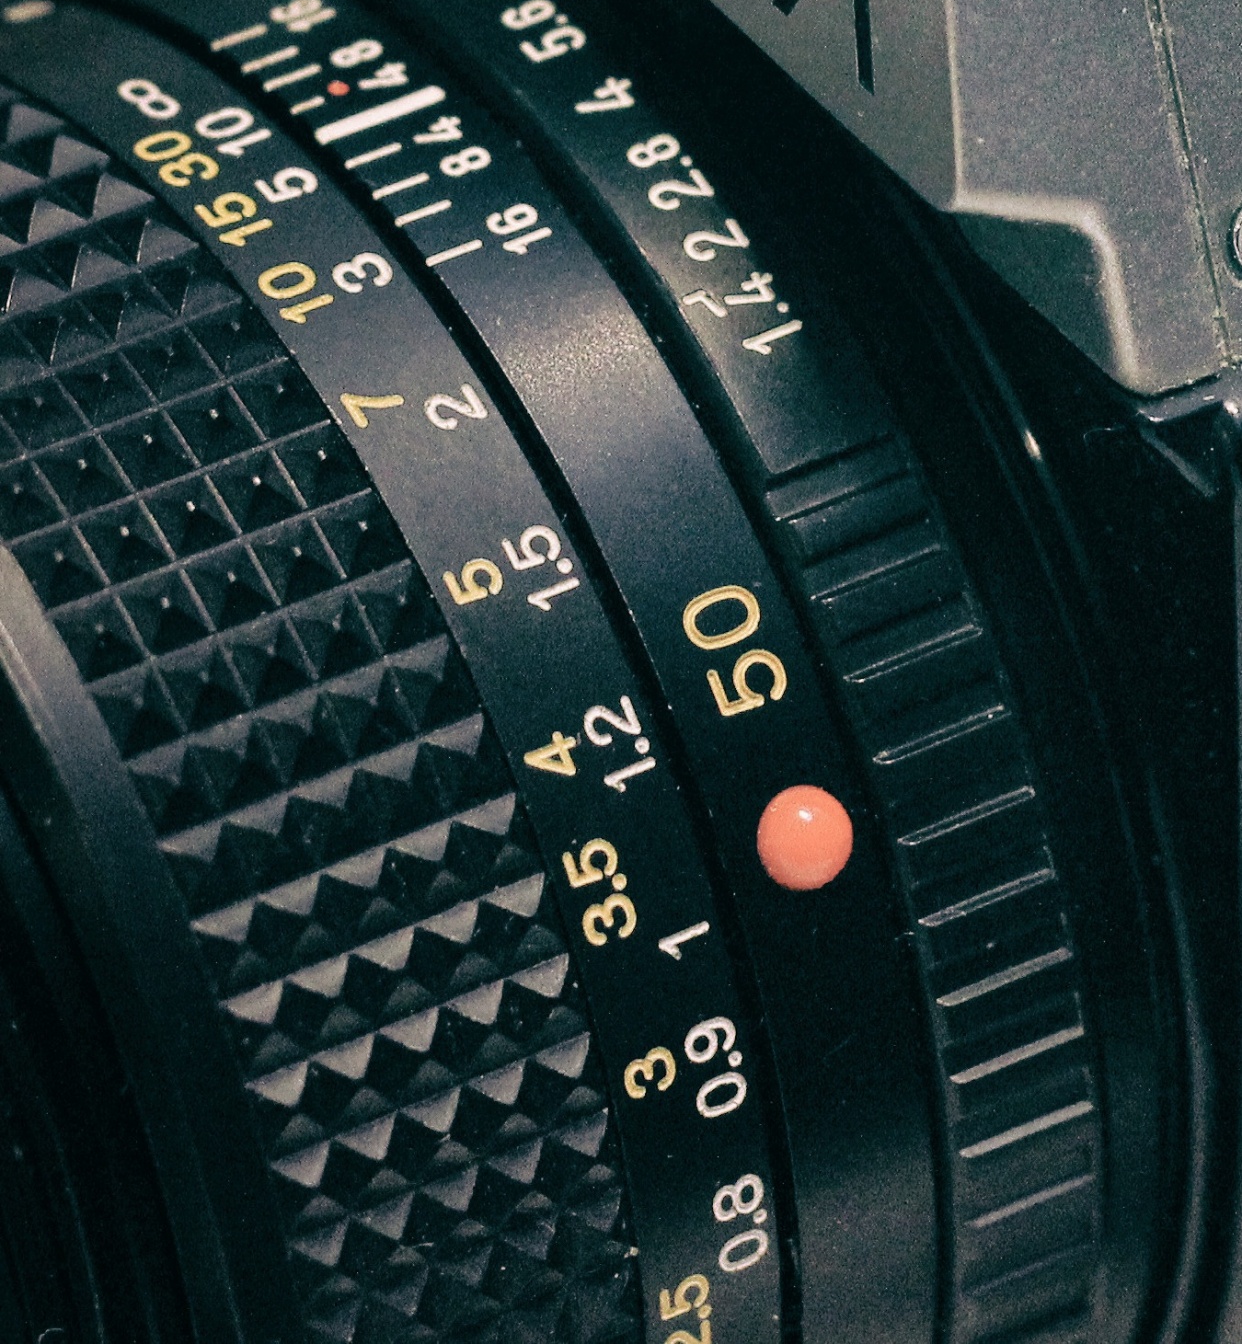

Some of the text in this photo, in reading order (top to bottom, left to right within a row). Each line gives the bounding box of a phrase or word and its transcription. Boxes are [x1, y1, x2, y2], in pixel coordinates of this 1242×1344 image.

[330, 39, 383, 68] 8
[358, 62, 409, 90] 4
[574, 77, 635, 114] 4
[194, 106, 272, 157] 10
[412, 116, 463, 144] 4
[133, 130, 220, 187] 30
[439, 145, 492, 177] 8
[626, 133, 715, 211] 2.8
[254, 166, 318, 204] 5
[194, 191, 273, 246] 15
[485, 203, 553, 255] 16
[683, 218, 750, 262] 2
[257, 261, 334, 324] 10
[331, 252, 393, 294] 3
[725, 271, 803, 356] 1.4
[339, 392, 404, 428] 7
[423, 383, 488, 430] 2
[442, 557, 503, 606] 5
[501, 524, 580, 611] 1.5
[682, 584, 788, 717] 50
[523, 731, 577, 777] 4
[583, 695, 657, 793] 1.2
[562, 837, 637, 947] 3.5
[658, 920, 710, 961] 1
[623, 1046, 677, 1099] 3
[684, 1016, 748, 1118] 0.9
[712, 1173, 769, 1273] 0.8
